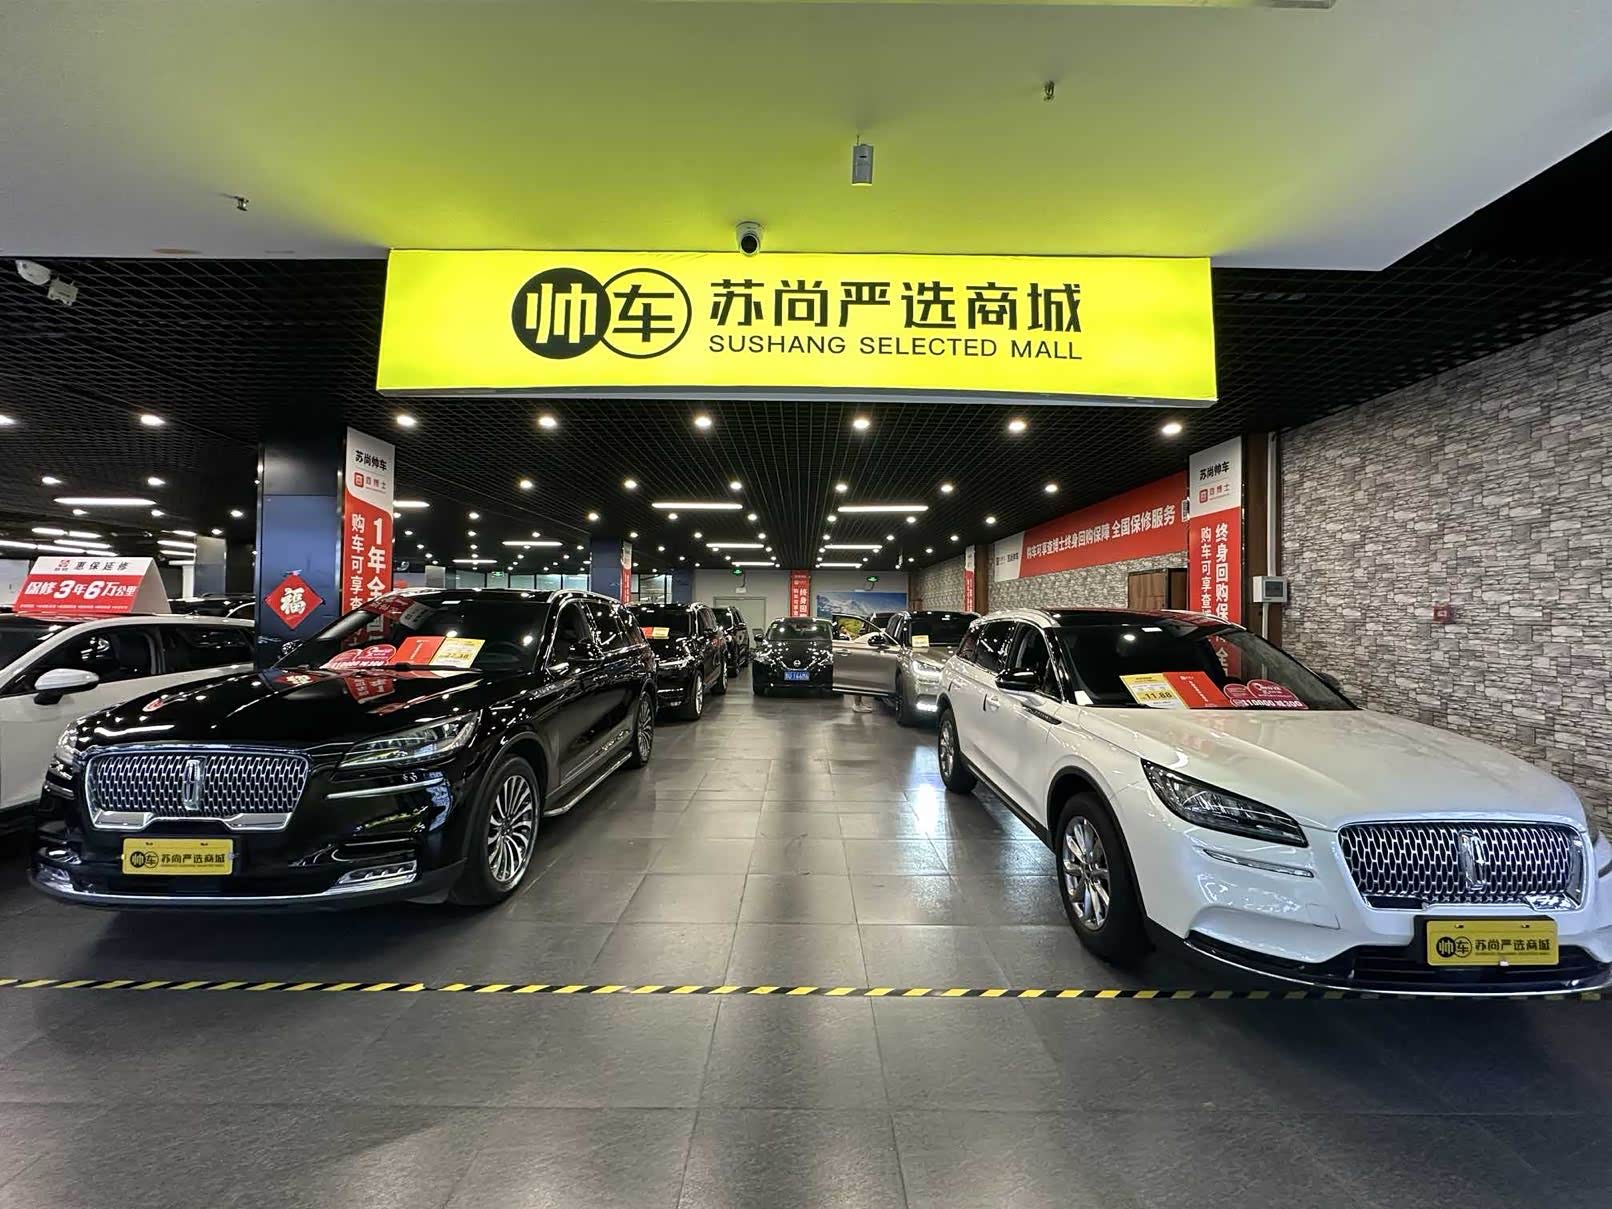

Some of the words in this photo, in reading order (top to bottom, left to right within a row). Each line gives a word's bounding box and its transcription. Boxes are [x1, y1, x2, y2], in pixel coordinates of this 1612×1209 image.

[709, 279, 1083, 334] 苏尚严选商城
[708, 335, 847, 355] SUSHANG
[860, 337, 998, 358] SELECTED
[1010, 339, 1083, 360] MALL
[355, 450, 388, 471] 苏尚帅车
[1199, 460, 1230, 481] 苏尚帅车
[1111, 504, 1176, 539] 全国保修服务
[24, 579, 138, 600] 保修3年6万公里
[281, 587, 307, 615] 福
[161, 853, 226, 864] 苏尚严选商城
[1475, 939, 1551, 952] 苏尚严选商城
